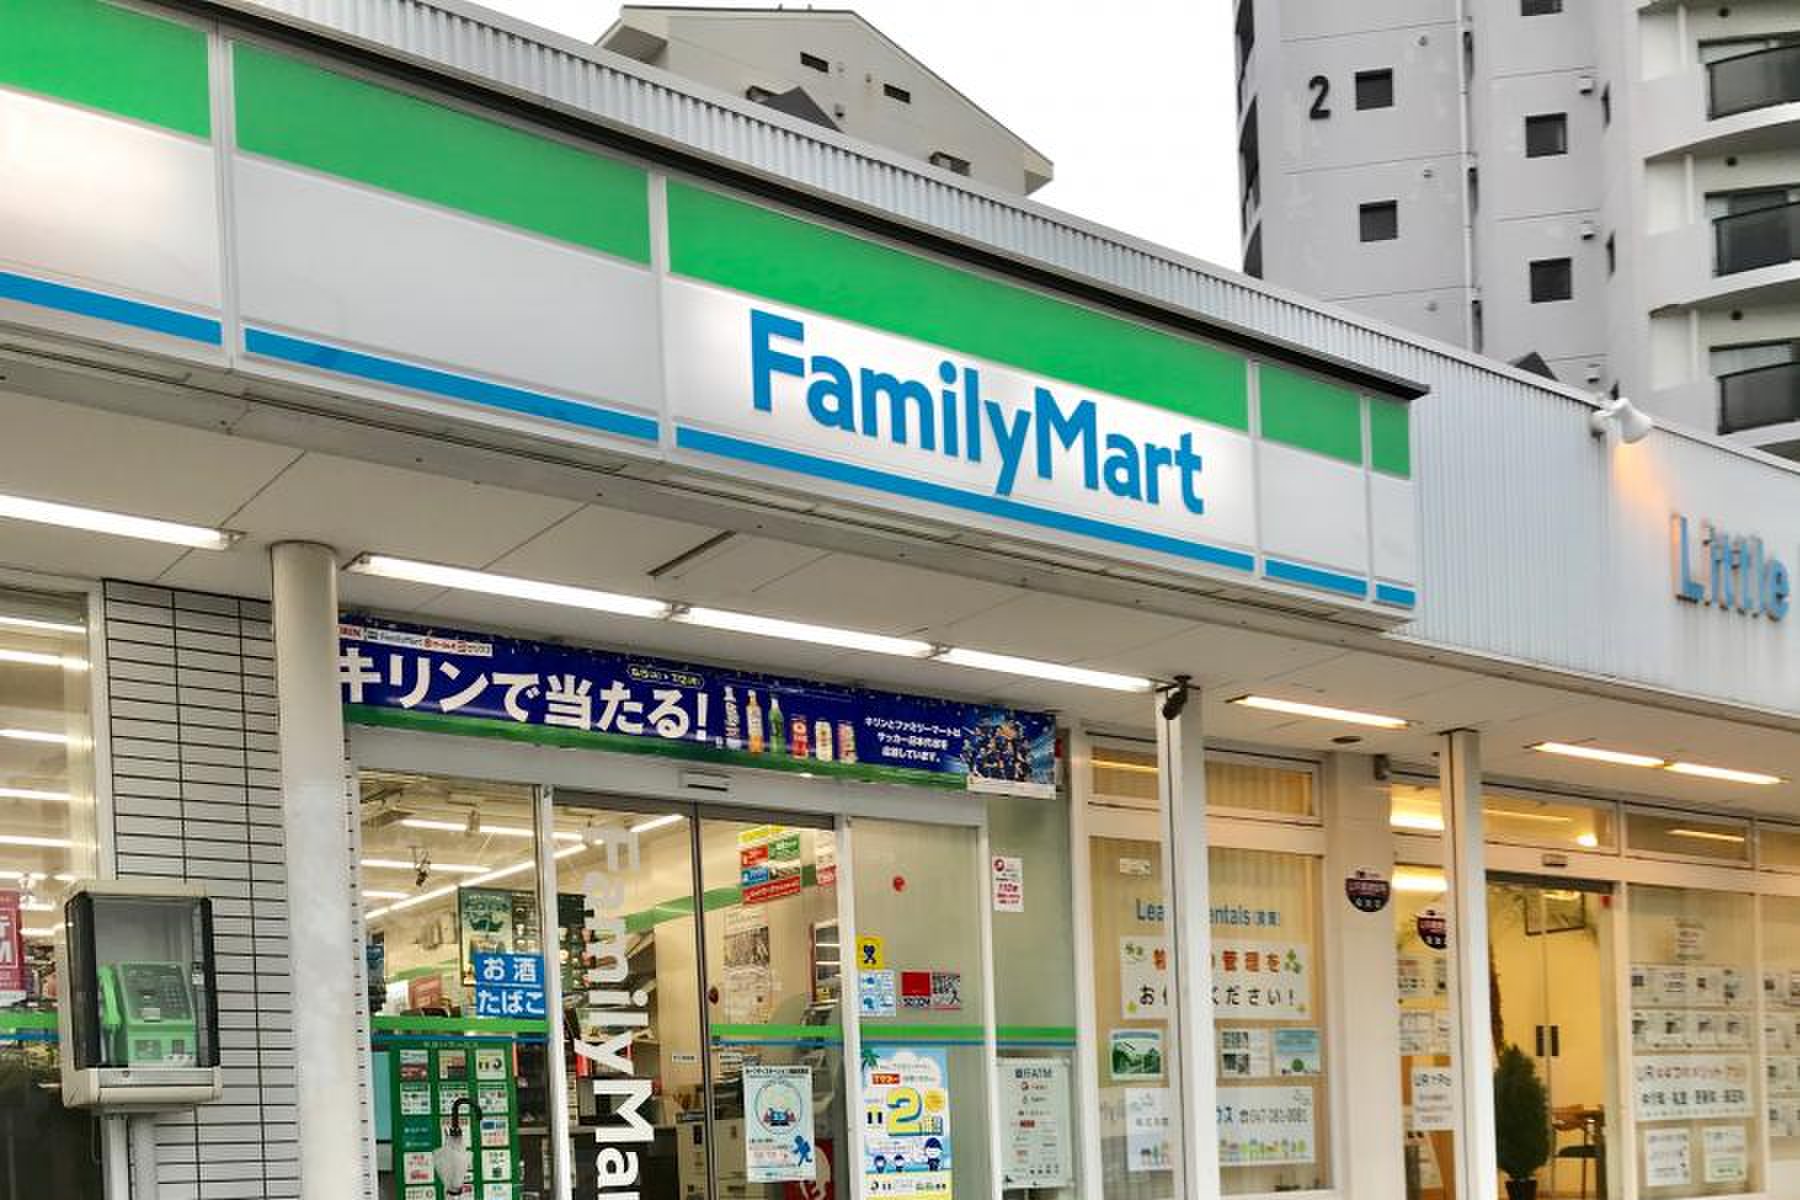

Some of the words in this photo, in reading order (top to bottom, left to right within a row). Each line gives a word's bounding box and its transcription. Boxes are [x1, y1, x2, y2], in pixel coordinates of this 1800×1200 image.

[1307, 75, 1332, 120] 2
[749, 308, 1205, 516] FamilyMart
[1671, 513, 1791, 622] Little
[482, 957, 536, 983] お酒
[478, 989, 545, 1014] たばこ
